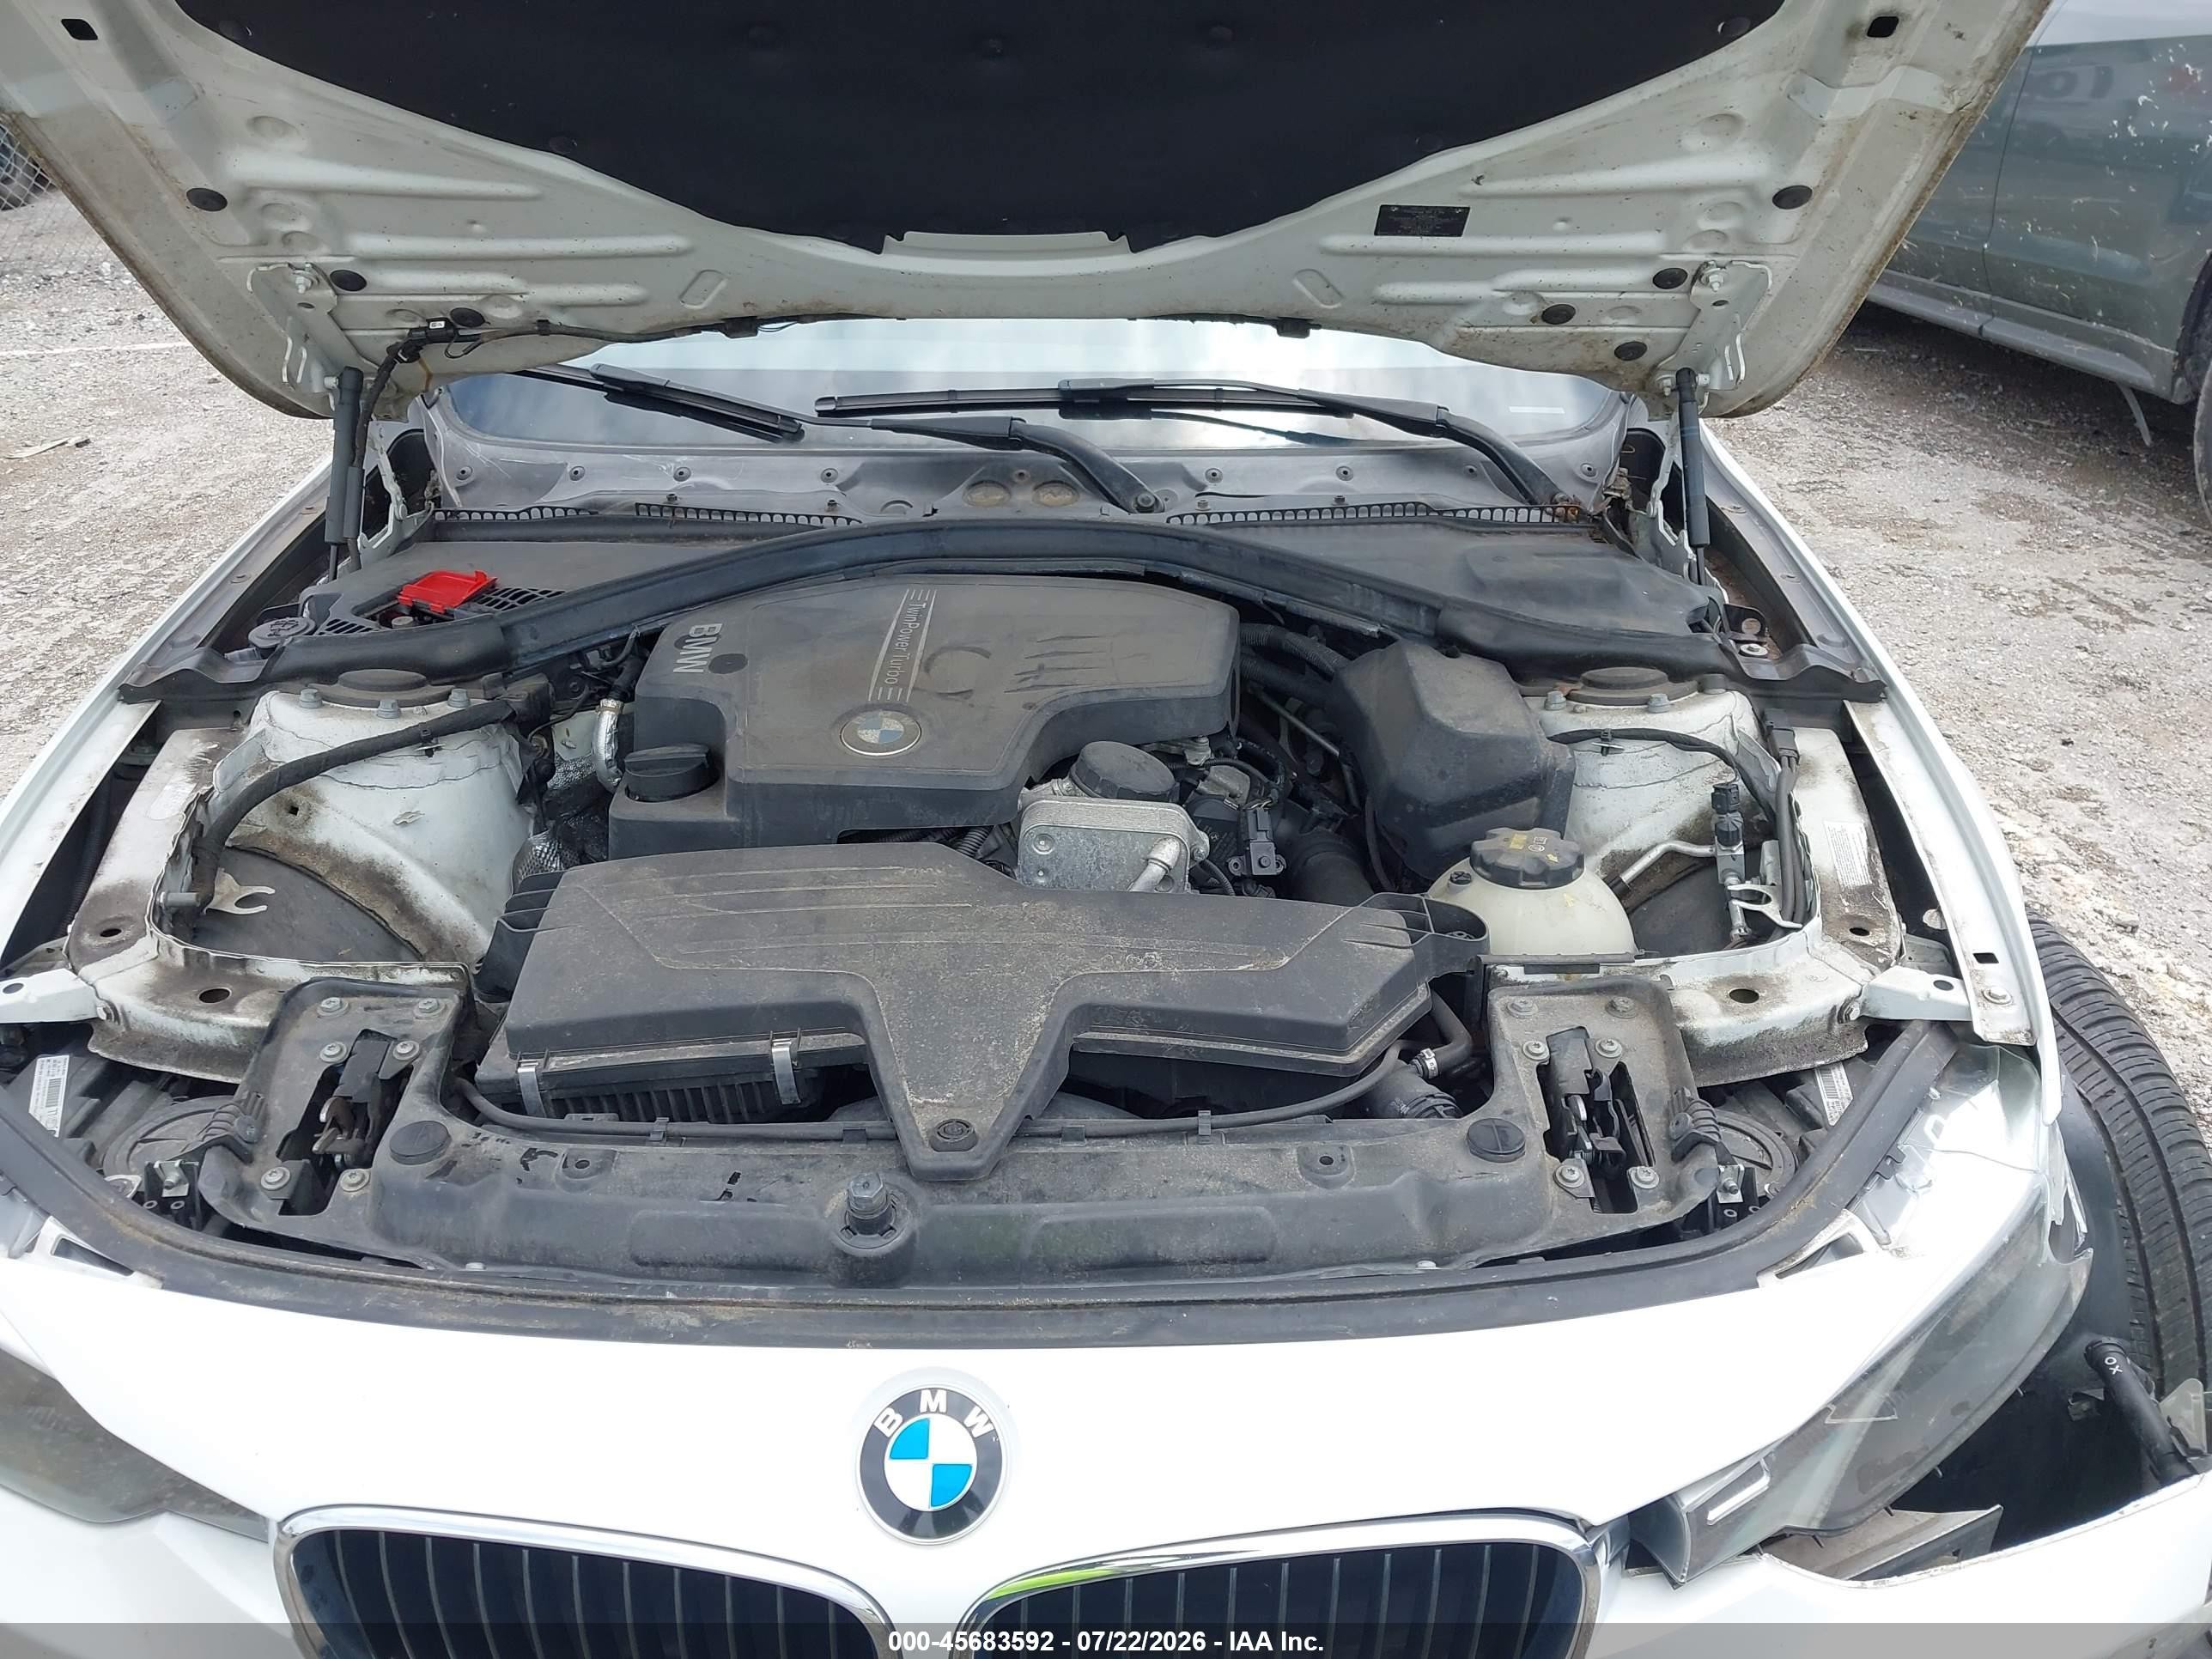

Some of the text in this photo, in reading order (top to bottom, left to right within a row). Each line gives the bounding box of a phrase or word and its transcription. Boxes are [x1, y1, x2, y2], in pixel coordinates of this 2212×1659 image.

[672, 623, 723, 674] BMW
[884, 602, 927, 685] TwinPower Turbo
[873, 1389, 995, 1438] BMW
